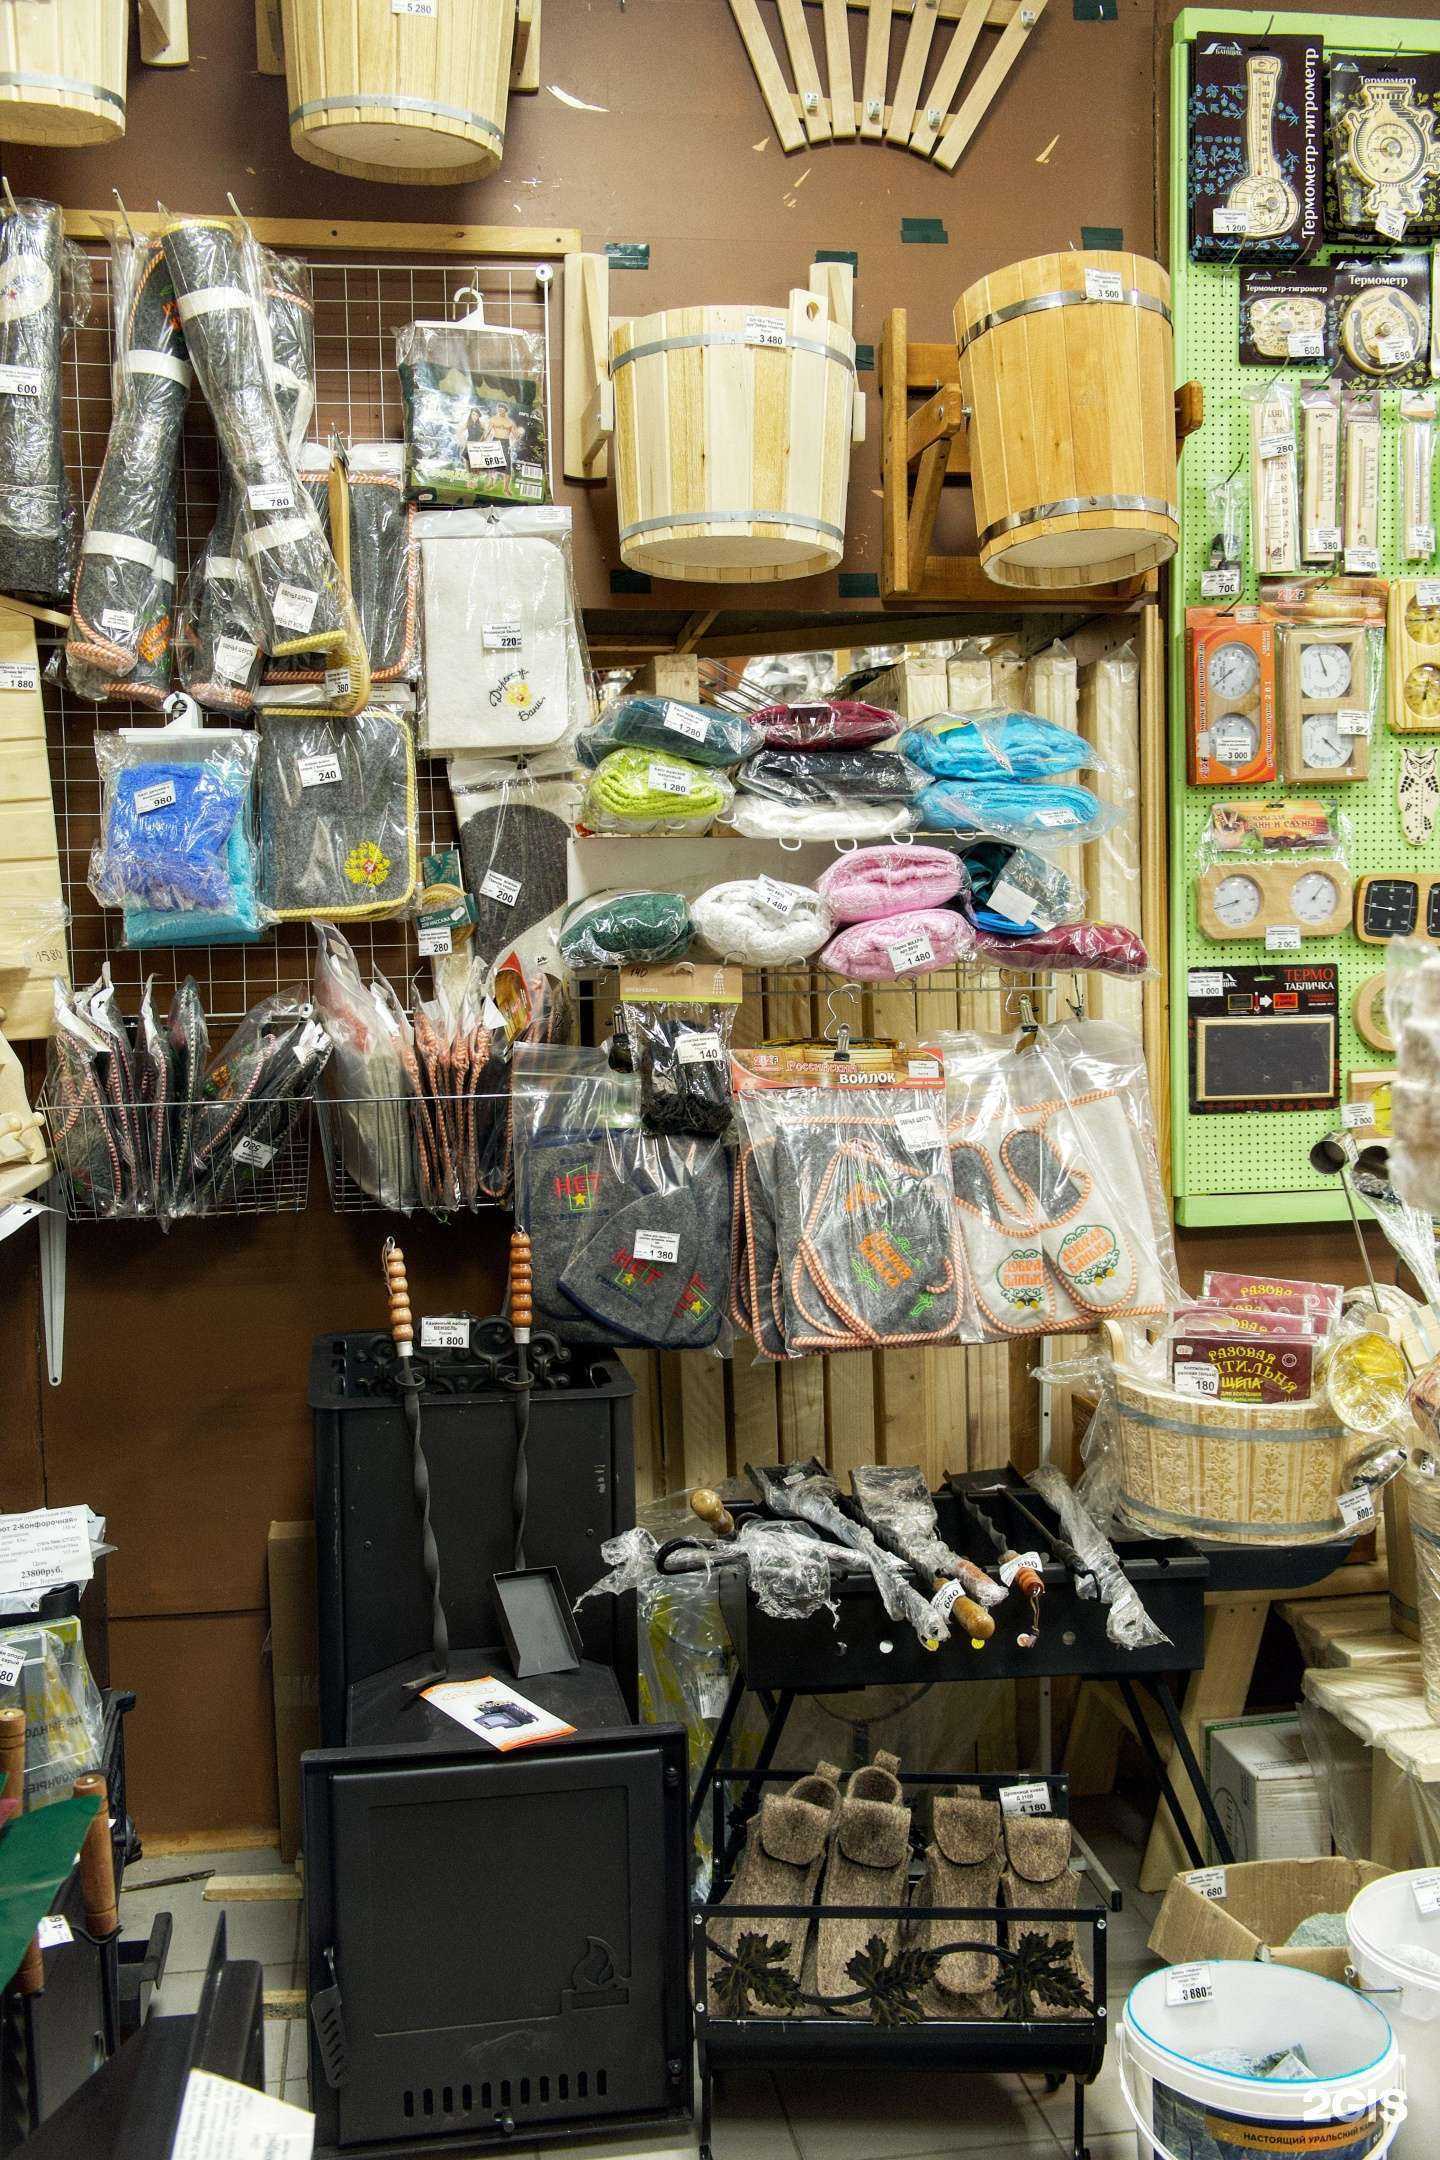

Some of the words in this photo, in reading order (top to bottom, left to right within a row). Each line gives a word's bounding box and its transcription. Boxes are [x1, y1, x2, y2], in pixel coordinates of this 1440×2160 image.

[415, 5, 432, 14] 280
[1302, 47, 1318, 239] Термометр-гигрометр
[1232, 224, 1247, 232] 200
[1348, 274, 1408, 288] Термометр
[1105, 290, 1119, 298] 500
[1245, 283, 1328, 294] Термометр-гигрометр
[767, 335, 783, 345] 480
[17, 385, 38, 395] 600
[1276, 444, 1294, 454] 280
[270, 498, 290, 507] 780
[501, 637, 517, 647] 220
[17, 680, 34, 689] 880
[685, 726, 701, 738] 280
[318, 770, 337, 782] 240
[670, 783, 686, 793] 280
[153, 795, 172, 807] 980
[496, 890, 514, 903] 200
[772, 901, 788, 912] 480
[433, 943, 449, 953] 280
[914, 951, 931, 962] 480
[1283, 969, 1335, 981] ТЕРМО
[1284, 982, 1335, 992] ТАБЛИЧКА
[700, 1048, 718, 1060] 140
[839, 1071, 896, 1085] ВОЙЛОК
[657, 1250, 673, 1260] 380
[446, 1337, 464, 1345] 800
[1208, 1345, 1277, 1365] РАЗОВАЯ
[1195, 1380, 1215, 1391] 180
[1221, 1376, 1263, 1390] ЩЕПА
[1356, 1506, 1369, 1521] 800
[21, 1568, 64, 1580] 23800руб.
[943, 1589, 959, 1609] 680
[1030, 1803, 1046, 1812] 180
[1206, 1886, 1222, 1897] 680
[1243, 2131, 1307, 2147] НАСТОЯЩИЙ
[1309, 2126, 1359, 2145] УРАЛЬСКИЙ
